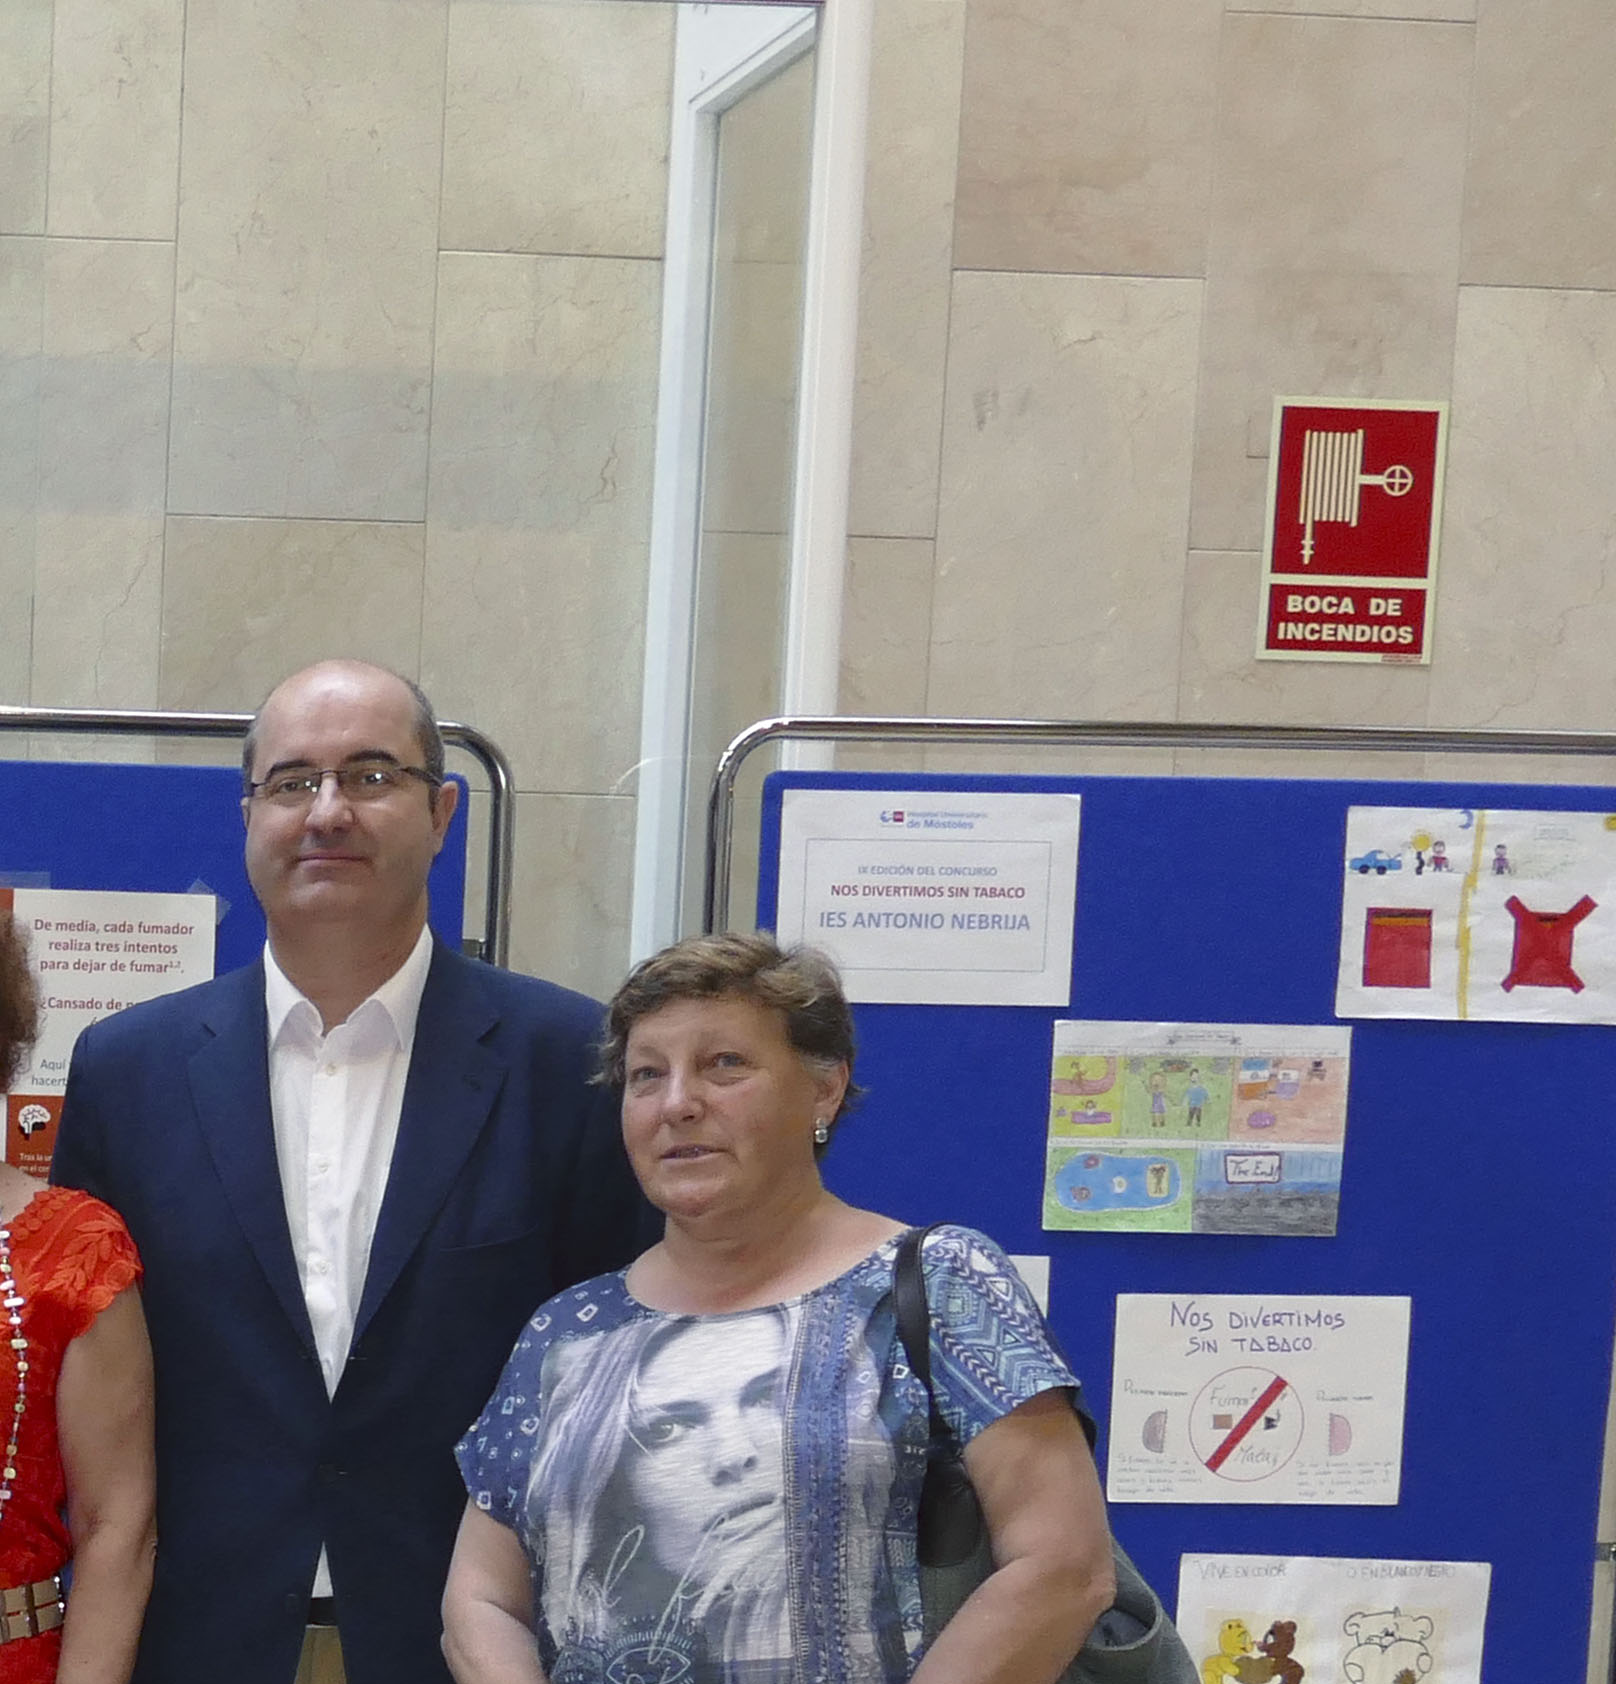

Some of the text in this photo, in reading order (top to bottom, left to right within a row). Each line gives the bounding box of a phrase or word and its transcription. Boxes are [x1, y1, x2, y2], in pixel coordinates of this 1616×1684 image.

[1286, 594, 1403, 616] BOCA DE
[1276, 621, 1414, 644] INCENDIOS
[906, 818, 921, 829] de
[857, 863, 998, 877] IX EDICIÓN DEL CONCURSO
[830, 884, 1026, 899] NOS DIVERTIMOS SIN TABACO
[33, 918, 195, 936] De media, cada fumador
[819, 911, 1031, 931] IES ANTONIO NEBRIJA
[48, 938, 179, 955] realiza tres intentos
[39, 958, 126, 974] para dejar de
[39, 996, 104, 1011] ¿Cansado
[106, 997, 122, 1011] de
[39, 1058, 67, 1071] Aquí
[1185, 1336, 1218, 1357] SIN
